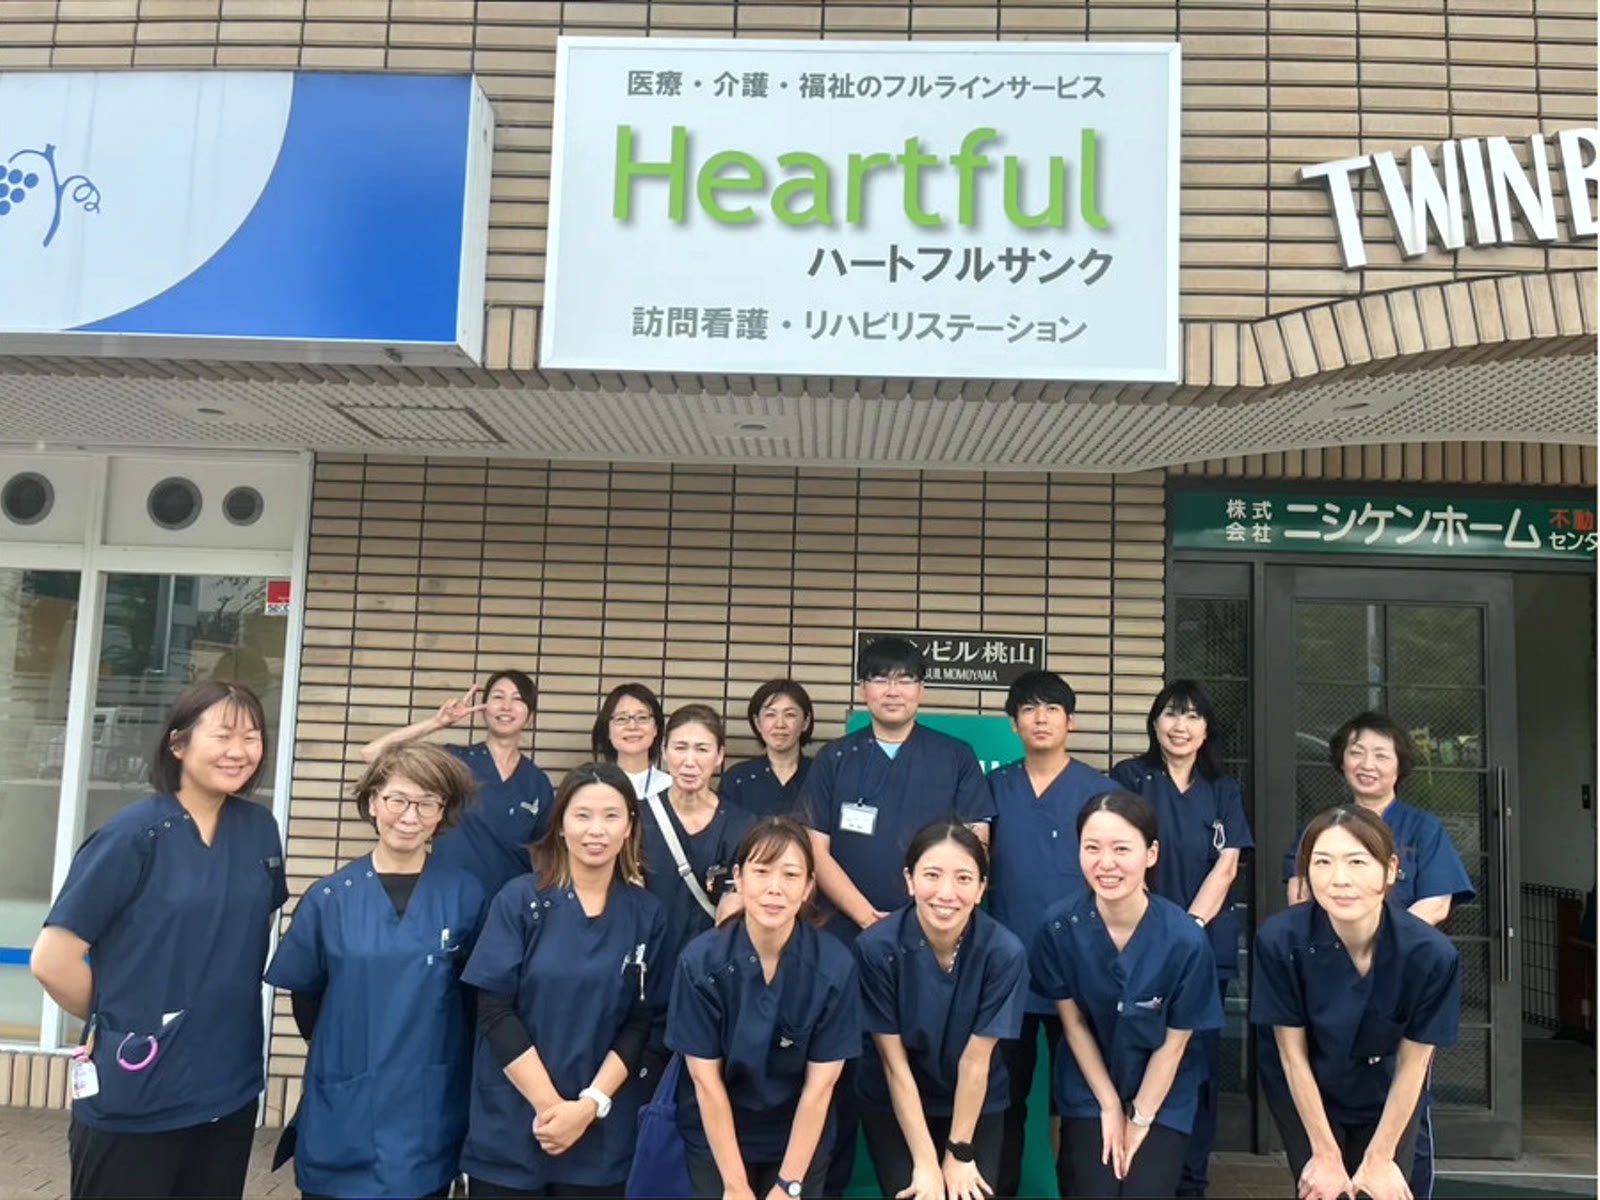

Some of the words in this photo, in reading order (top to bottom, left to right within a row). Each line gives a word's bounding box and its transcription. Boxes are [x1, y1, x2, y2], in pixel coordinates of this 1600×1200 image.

[627, 70, 1106, 100] 医療・介護・福祉のフルラインサービス
[613, 125, 1107, 229] Heartful
[807, 244, 1114, 285] ハートフルサンク
[632, 305, 1088, 344] 訪問看護・リハビリステーション
[1283, 503, 1541, 549] ニシケンホーム
[943, 667, 998, 682] MOMOYAMA
